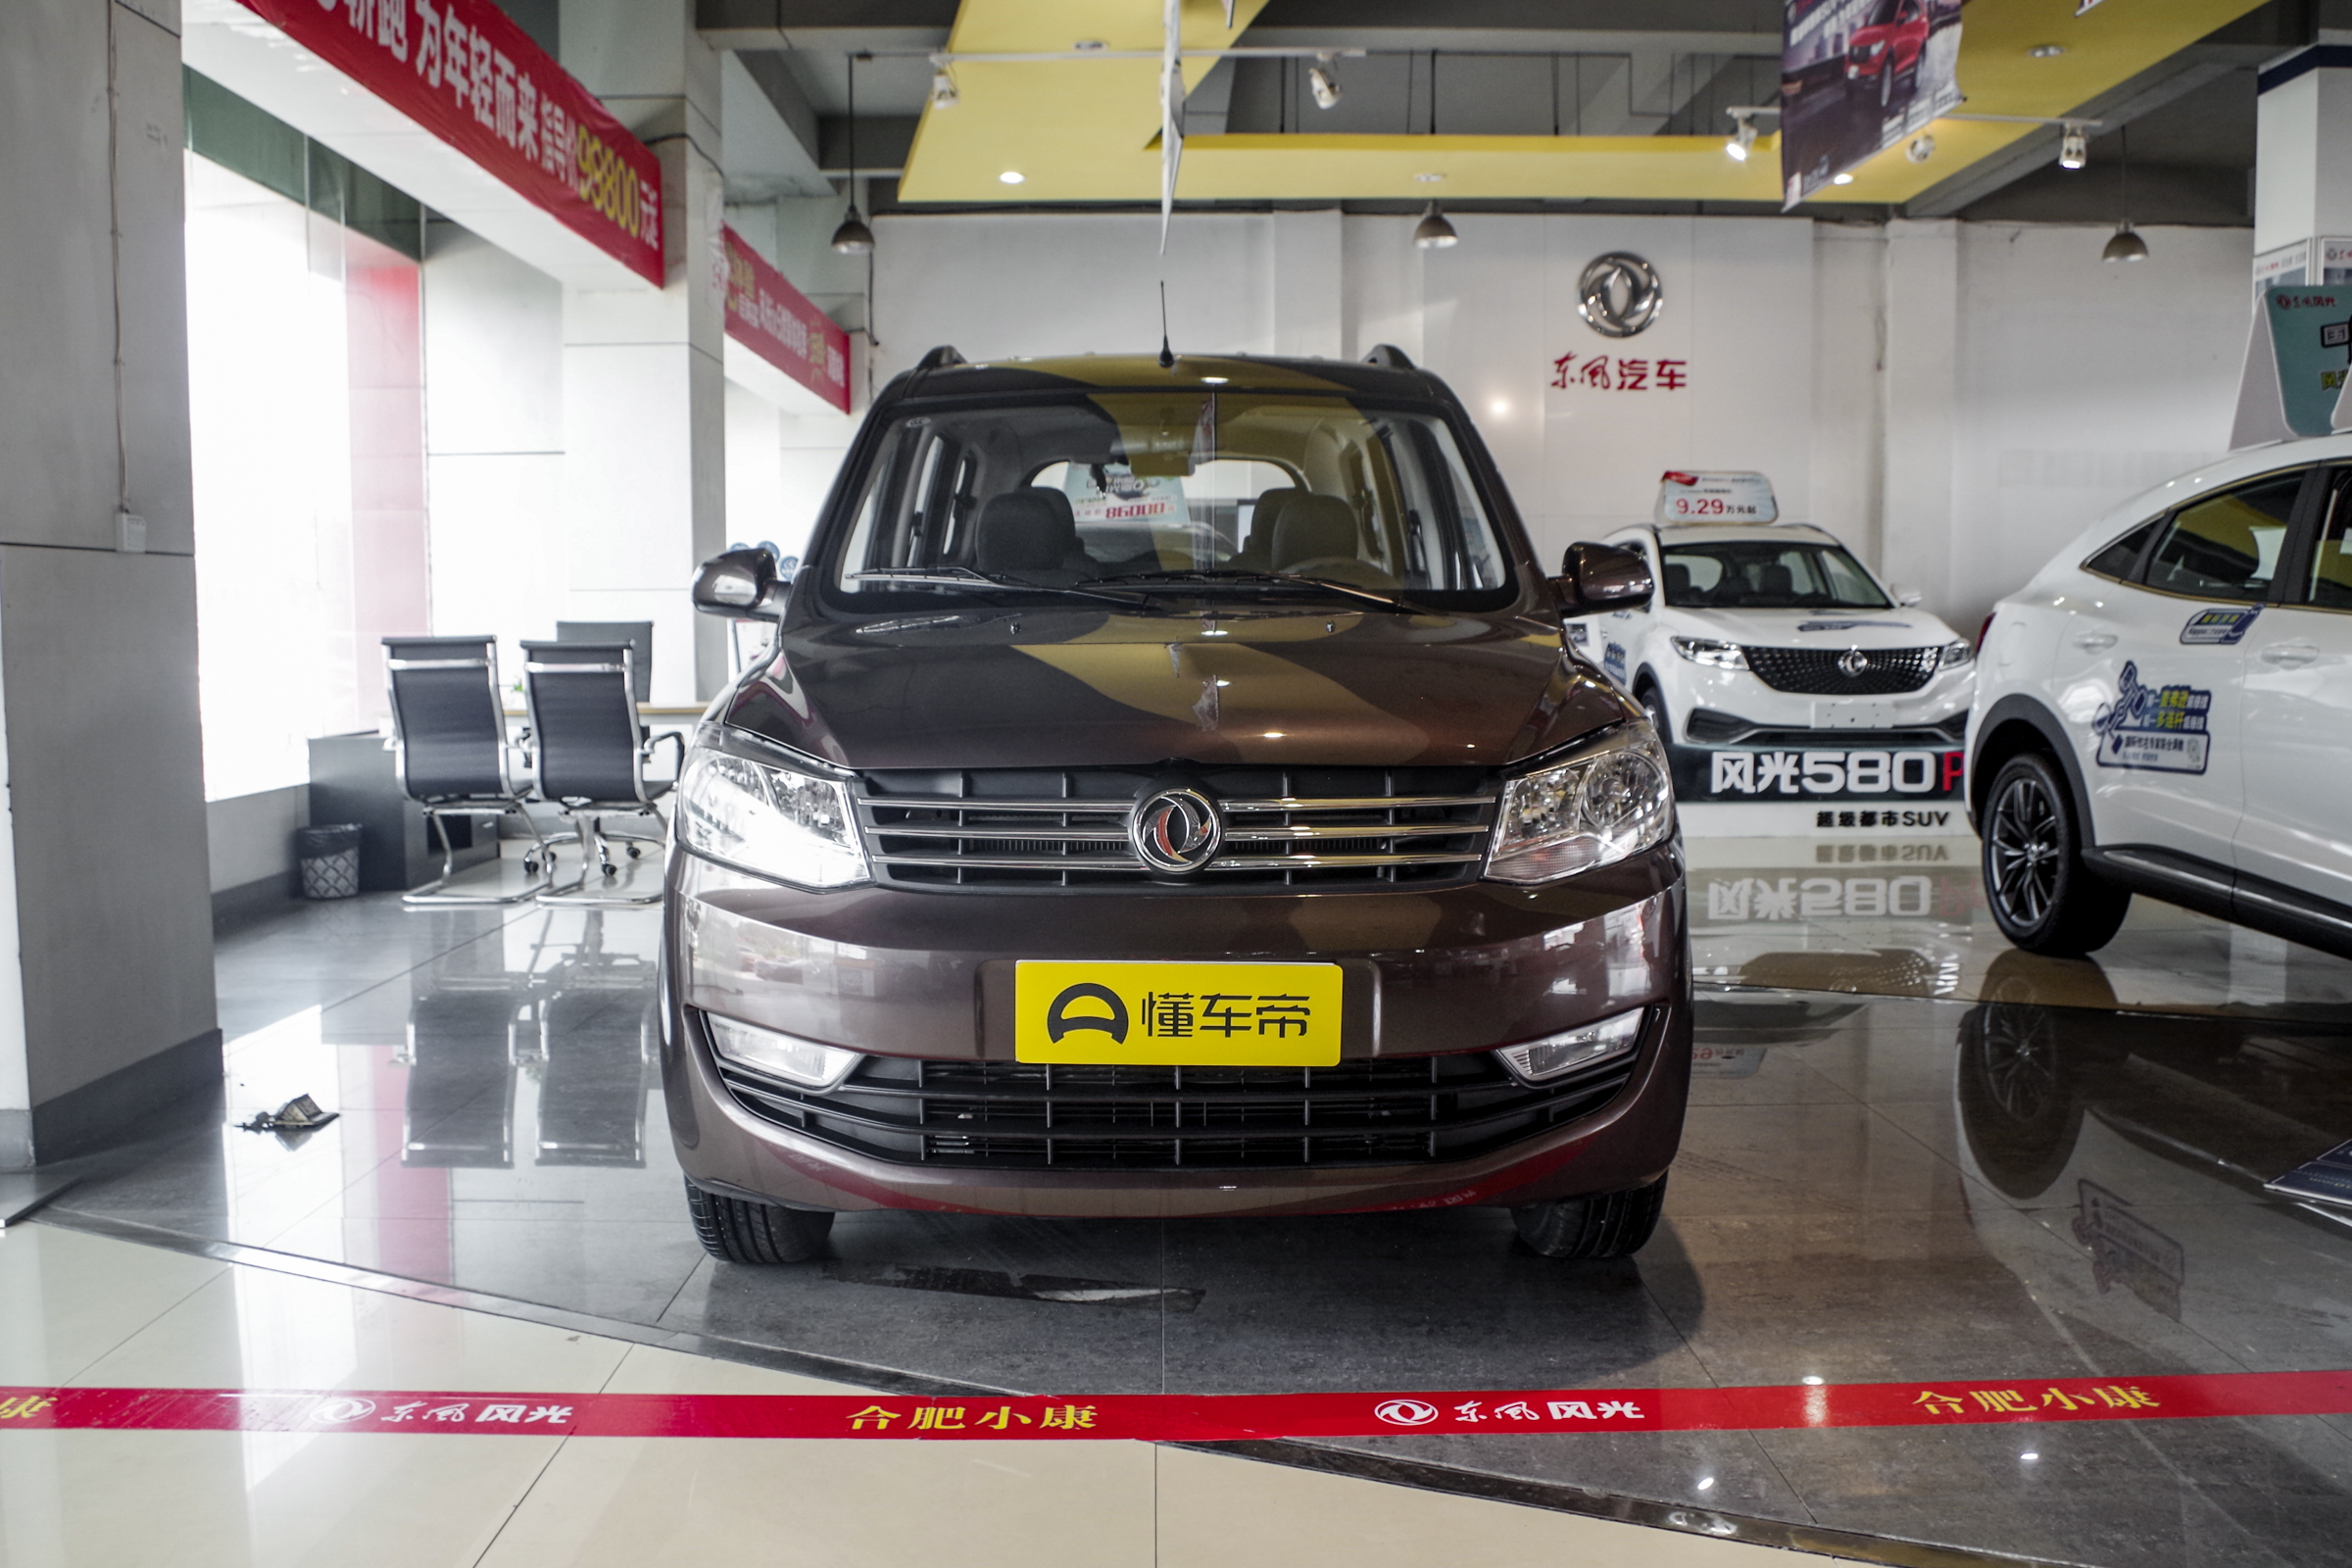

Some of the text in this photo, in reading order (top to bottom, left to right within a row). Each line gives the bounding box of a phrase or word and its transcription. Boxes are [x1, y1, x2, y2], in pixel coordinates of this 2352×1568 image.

[1551, 351, 1686, 390] 东风汽车
[1142, 992, 1311, 1038] 懂车帝
[381, 1401, 573, 1423] 东风风光
[1454, 1400, 1644, 1423] 东风风光
[1912, 1386, 2160, 1414] 合肥小康
[846, 1405, 1099, 1430] 合肥小康
